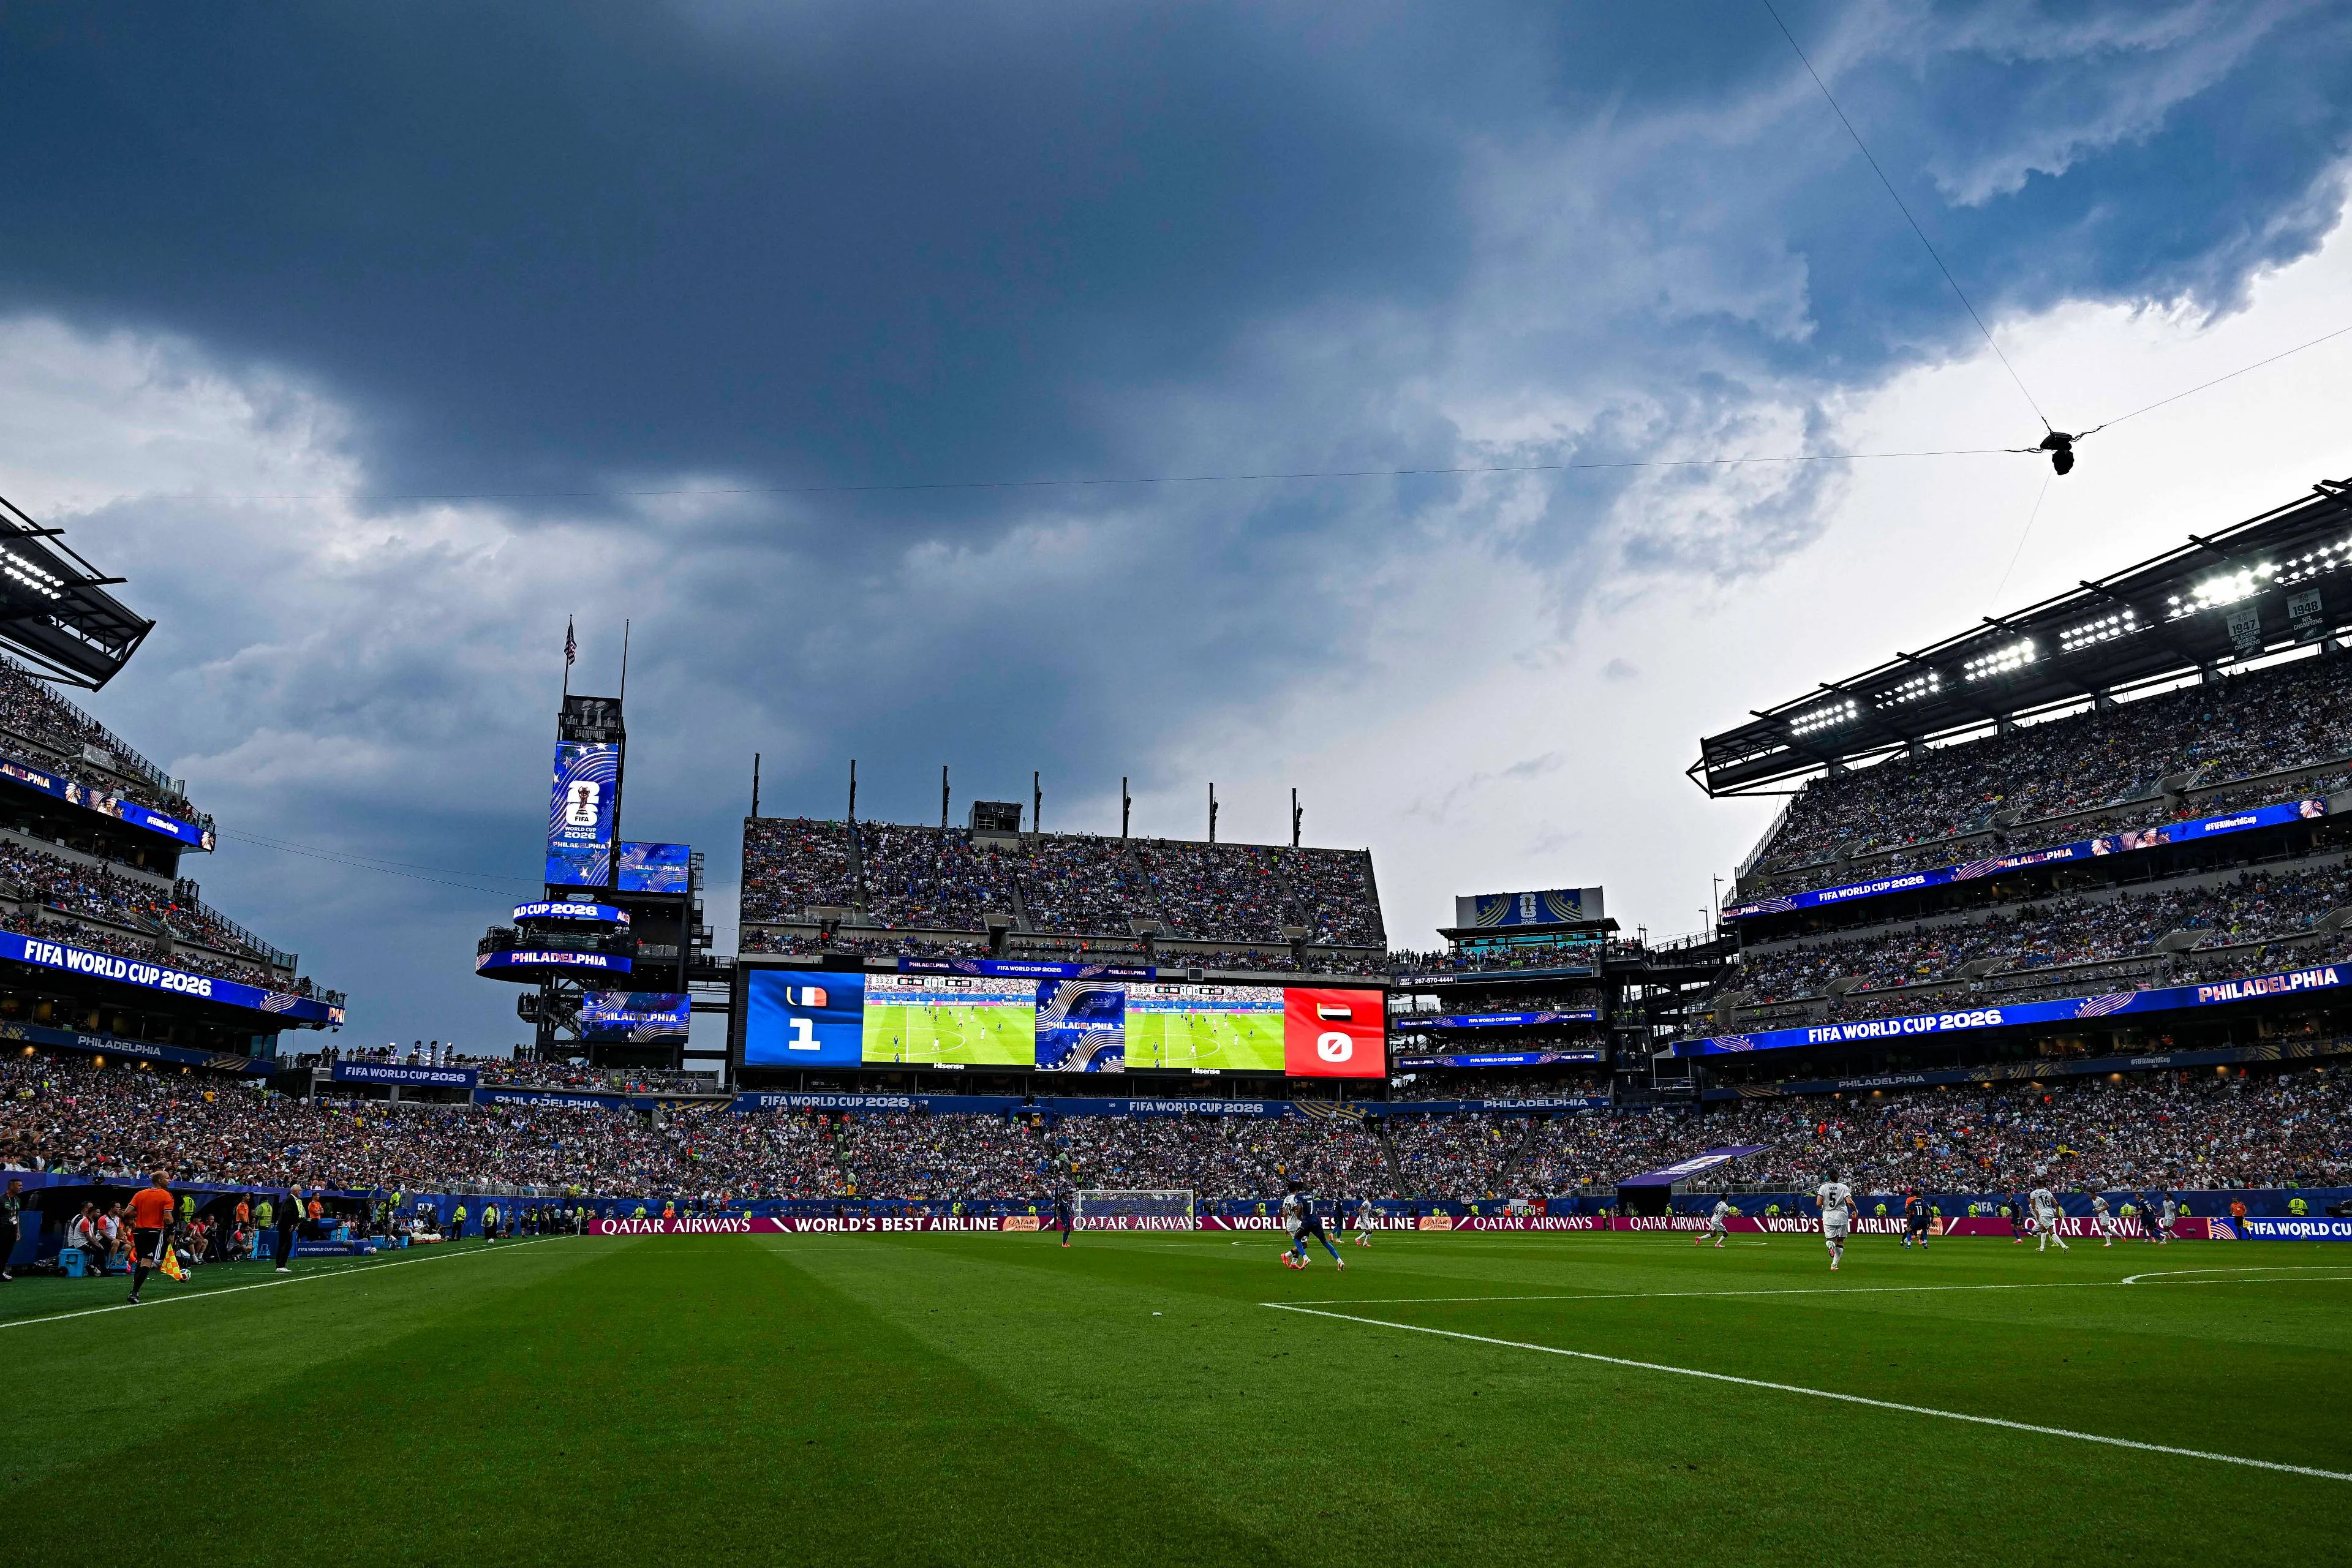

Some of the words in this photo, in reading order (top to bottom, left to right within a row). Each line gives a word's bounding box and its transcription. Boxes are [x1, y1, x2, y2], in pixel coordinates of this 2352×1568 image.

[2293, 601, 2318, 617] 1948
[2231, 620, 2256, 635] 1947
[2293, 617, 2323, 630] CHAMPIONS
[2237, 635, 2256, 645] DIVISION
[2240, 630, 2260, 641] EASTERN
[2234, 639, 2261, 650] CHAMPIONS
[575, 729, 606, 739] CHAMPIONS
[0, 764, 50, 789] ADELPHIA
[2205, 816, 2257, 832] #FIFAWorldCup
[1997, 848, 2073, 868] PHILADELPHIA
[1819, 891, 1838, 902] FIFA
[1838, 886, 1870, 899] WORLD
[1872, 882, 1891, 892] CUP
[1891, 875, 1924, 889] 2026
[527, 904, 549, 914] CUP
[551, 904, 597, 916] 2026
[1721, 905, 1759, 918] ADELPHIA
[511, 952, 606, 966] PHILADELPHIA
[24, 940, 63, 967] FIFA
[67, 949, 126, 978] WORLD
[128, 963, 159, 985] CUP
[160, 971, 211, 997] 2026
[2199, 967, 2339, 1003] PHILADELPHIA
[595, 1012, 677, 1022] PHILADELPHIA
[1047, 1022, 1114, 1031] PHILADELPHIA
[1808, 1027, 1841, 1042] FIFA
[1842, 1020, 1901, 1039] WORLD
[1903, 1015, 1937, 1033] CUP
[1939, 1009, 2003, 1030] 2026
[789, 1018, 821, 1050] 1
[78, 1035, 160, 1056] PHILADELPHIA
[1317, 1031, 1352, 1062] 0
[2130, 1057, 2170, 1065] #FIFAWorldCup
[345, 1066, 368, 1076] FIFA
[370, 1068, 407, 1079] WORLD
[409, 1071, 429, 1080] CUP
[431, 1072, 466, 1082] 2026
[1838, 1075, 1924, 1088] PHILADELPHIA
[495, 1096, 600, 1108] PHILADELPHIA
[760, 1096, 787, 1105] FIFA
[790, 1096, 836, 1106] WORLD
[838, 1097, 864, 1106] CUP
[865, 1097, 910, 1107] 2026
[1129, 1102, 1154, 1111] FIFA
[1156, 1102, 1197, 1112] WORLD
[1199, 1103, 1222, 1112] CUP
[1224, 1104, 1264, 1113] 2026
[1483, 1099, 1588, 1108] PHILADELPHIA
[1307, 1200, 1313, 1214] 7
[1829, 1193, 1836, 1208] 5
[2039, 1196, 2051, 1207] 16
[1915, 1205, 1923, 1216] 11
[2146, 1204, 2153, 1213] 14
[601, 1219, 665, 1235] QATAR
[673, 1218, 750, 1233] AIRWAYS
[795, 1218, 875, 1232] WORLD’S
[881, 1218, 927, 1231] BEST
[930, 1218, 998, 1231] AIRLINE
[1073, 1216, 1128, 1231] QATAR
[1134, 1216, 1202, 1229] AIRWAYS
[1354, 1216, 1420, 1230] ARLINE
[1474, 1216, 1523, 1231] QATAR
[1531, 1216, 1593, 1229] AIRWAYS
[1630, 1217, 1668, 1231] QATAR
[1672, 1216, 1711, 1230] AIRWAYS
[1767, 1218, 1819, 1232] WORLD’S
[2025, 1218, 2082, 1235] QTAR
[2277, 1223, 2329, 1235] WORLD
[2332, 1223, 2352, 1236] CU
